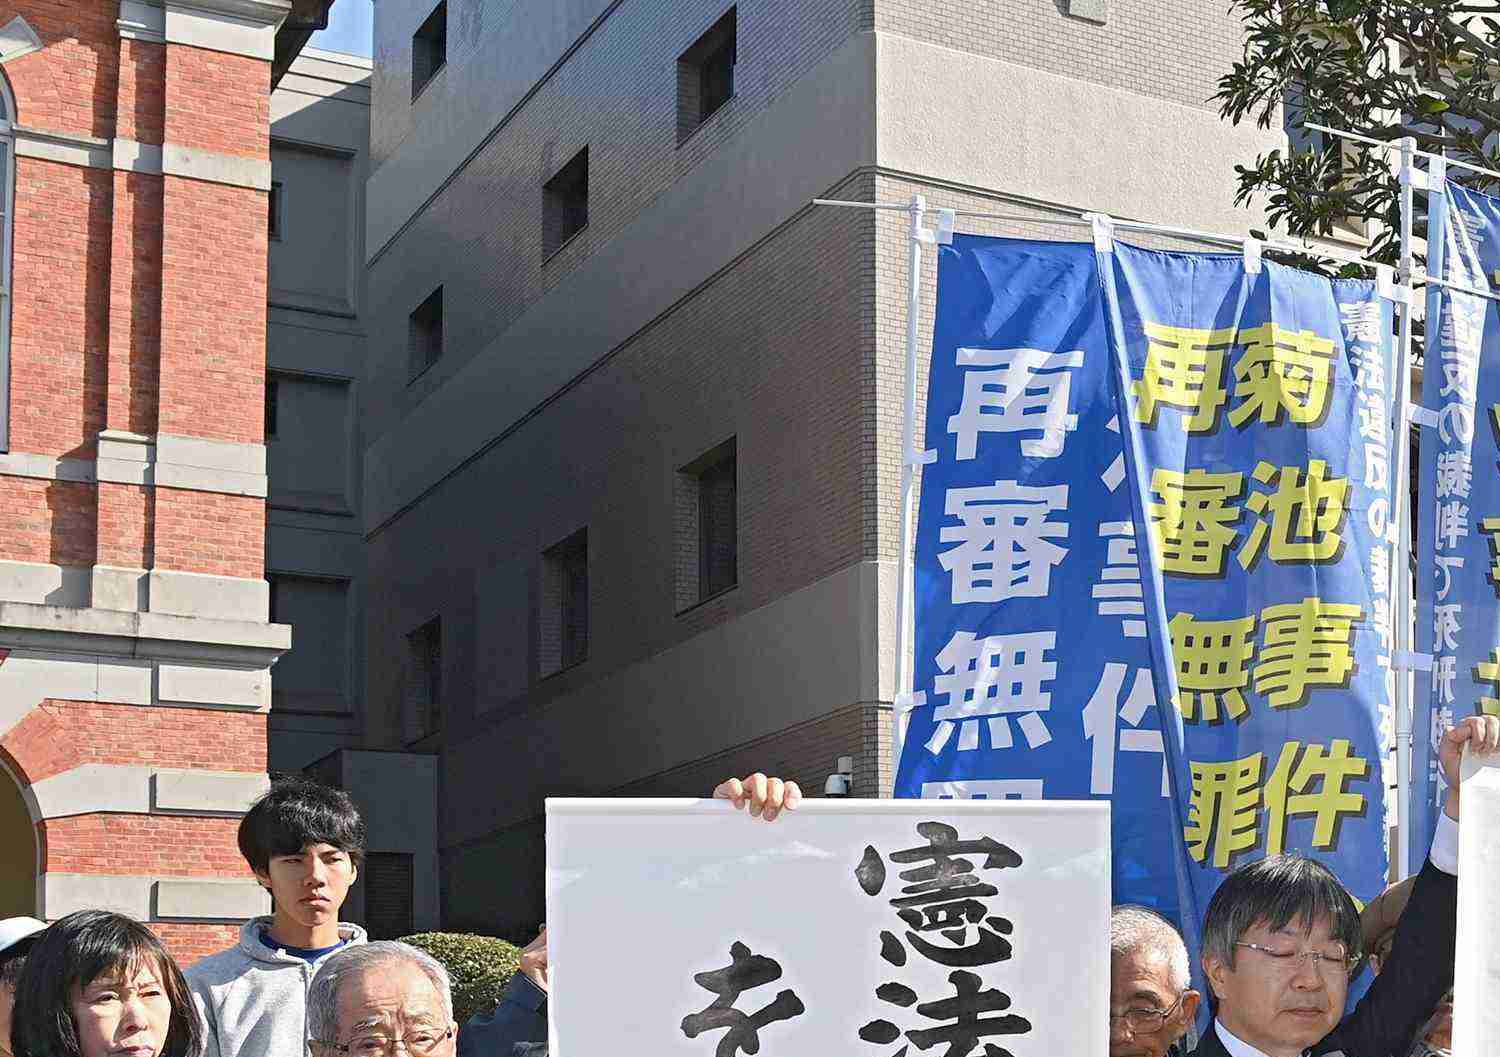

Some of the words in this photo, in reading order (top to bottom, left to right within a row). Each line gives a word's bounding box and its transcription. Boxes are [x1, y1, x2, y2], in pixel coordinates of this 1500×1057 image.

[921, 347, 1084, 800] 再審無
[1131, 320, 1263, 868] 再審無罪
[1227, 322, 1368, 858] 菊池事件
